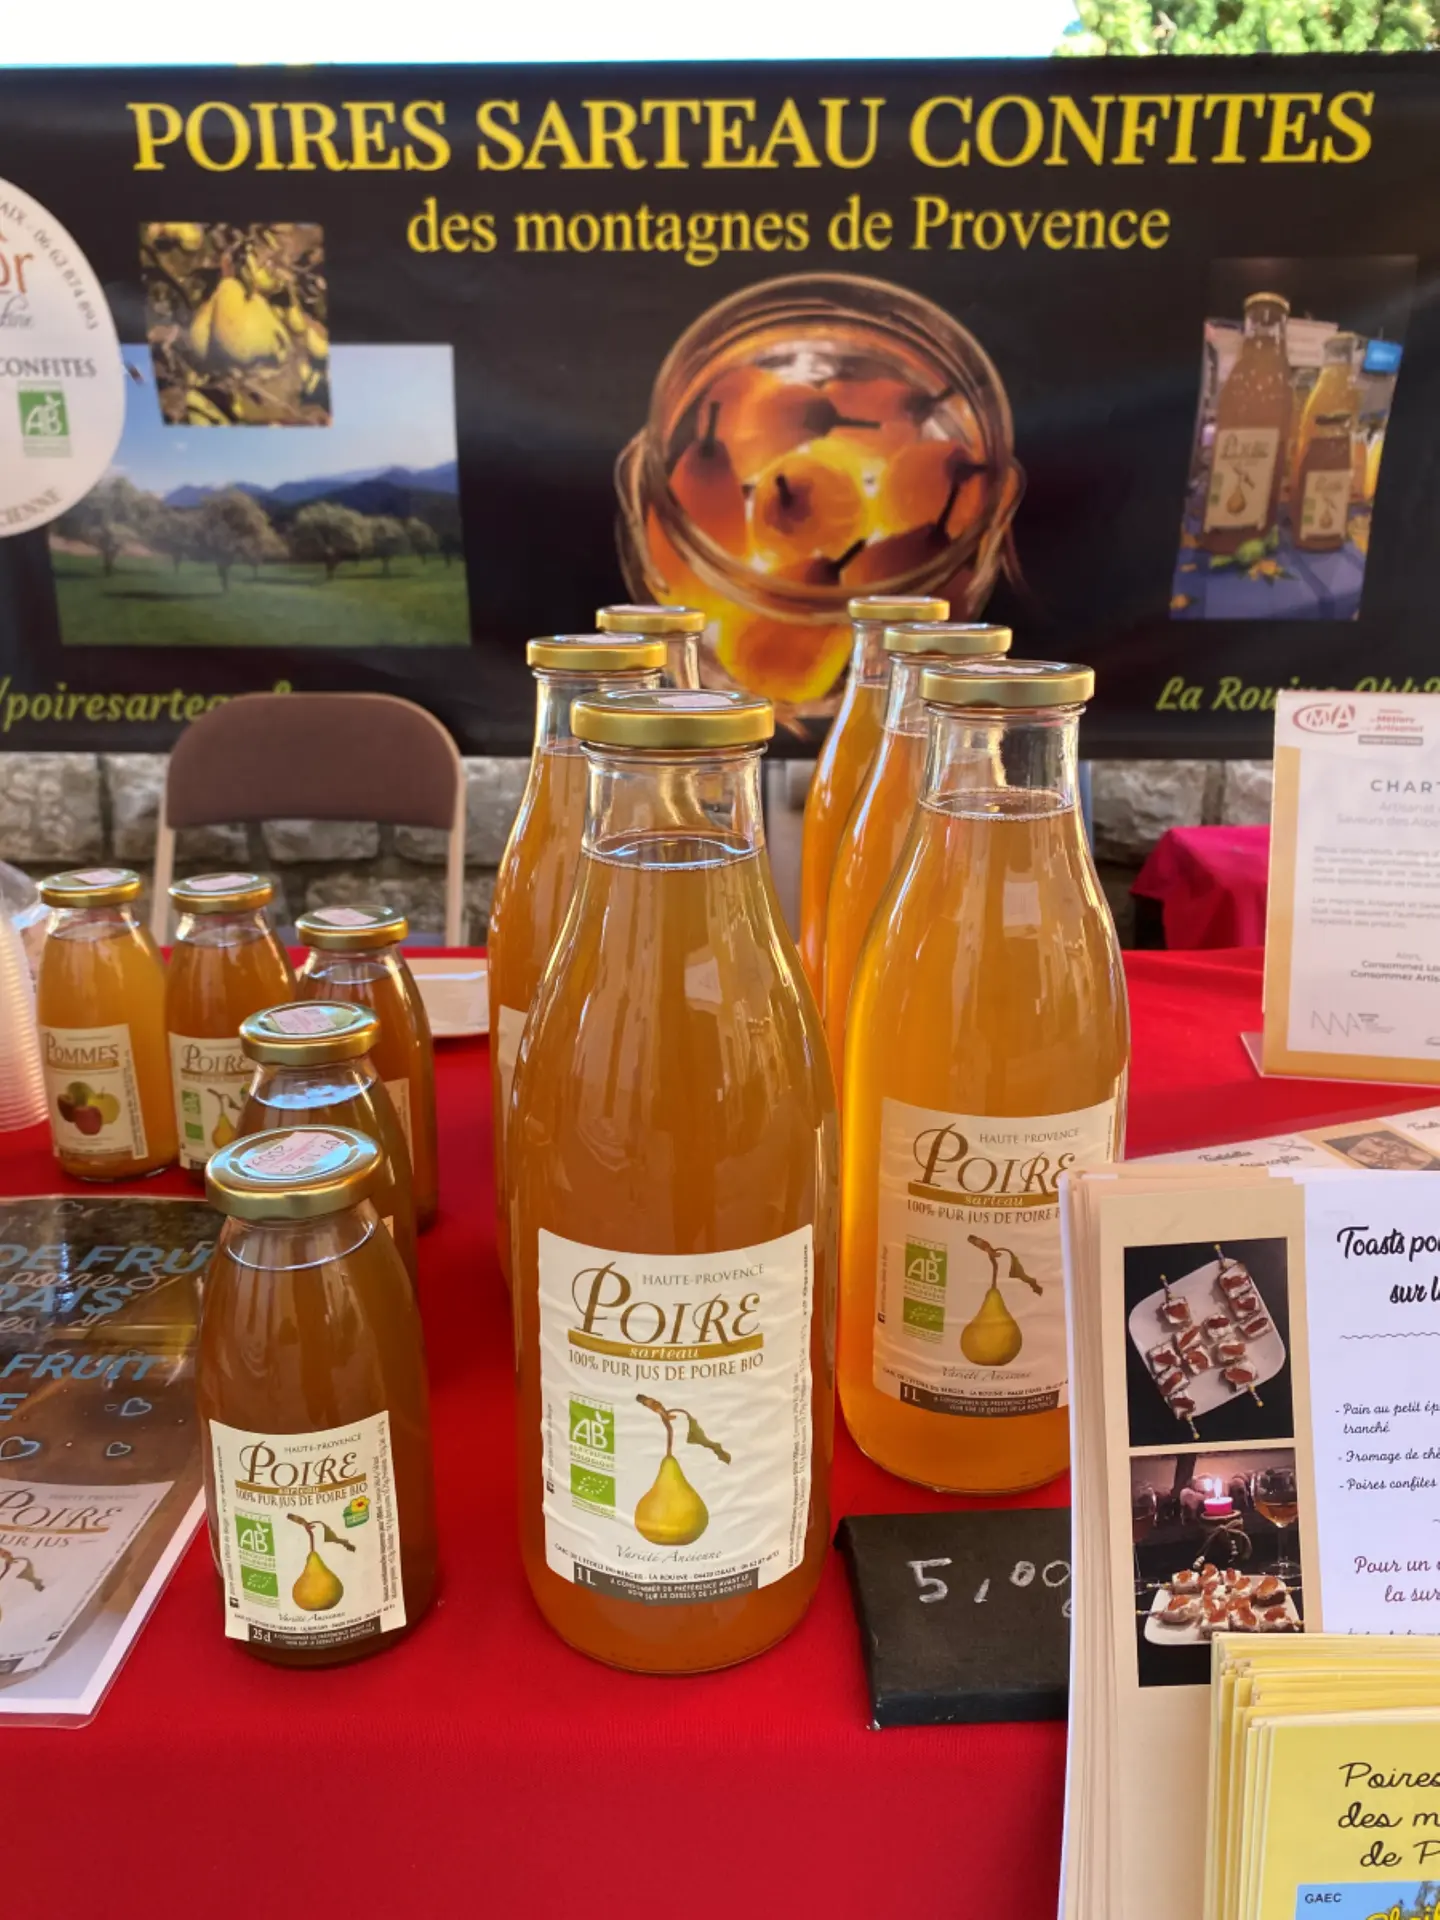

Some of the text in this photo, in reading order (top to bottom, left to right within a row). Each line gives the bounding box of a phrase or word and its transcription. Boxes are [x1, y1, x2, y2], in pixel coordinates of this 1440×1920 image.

[126, 91, 1376, 172] POIRES SARTEAU CONFITES
[406, 193, 1171, 266] des montagnes de Provence
[1155, 676, 1204, 711] La
[1370, 778, 1440, 794] CHAR
[43, 1031, 119, 1063] POMMES
[979, 1127, 1081, 1145] HAUTE-PROVENCE
[913, 1122, 1075, 1197] POIRE
[907, 1199, 936, 1216] 100%
[938, 1206, 964, 1222] PUR
[968, 1209, 989, 1224] JUS
[994, 1211, 1012, 1224] DE
[1015, 1208, 1051, 1223] POIRE
[1336, 1225, 1406, 1259] Toasts
[76, 1245, 213, 1272] FRU
[907, 1256, 940, 1284] AB
[642, 1263, 765, 1286] HAUTE-PROVENCE
[571, 1261, 761, 1346] POIRE
[1389, 1283, 1428, 1304] sur
[568, 1349, 765, 1381] 100% PUR JUS DE POIRE BIO
[629, 1347, 701, 1361] sarteau
[2, 1353, 164, 1381] FRUIT
[1343, 1402, 1371, 1415] Pain
[1373, 1406, 1390, 1414] au
[1393, 1401, 1421, 1416] petit
[572, 1417, 608, 1450] AB
[1343, 1421, 1391, 1435] tranché
[284, 1433, 362, 1454] HAUTE-PROVENCE
[1345, 1450, 1402, 1464] Fromage
[1405, 1447, 1419, 1460] de
[239, 1440, 357, 1487] POIRE
[1346, 1477, 1387, 1491] Poires
[1389, 1475, 1438, 1491] confites
[235, 1482, 369, 1510] 100% PUR JUS DE POIRE BIO
[32, 1536, 72, 1550] JUS
[240, 1529, 269, 1553] AB
[616, 1544, 722, 1563] Variété Ancienne
[1354, 1555, 1431, 1574] Pour un
[1384, 1584, 1406, 1603] la
[253, 1627, 263, 1640] 25
[1338, 1800, 1403, 1829] des
[1360, 1840, 1403, 1868] de
[1304, 1892, 1343, 1904] GAEC
